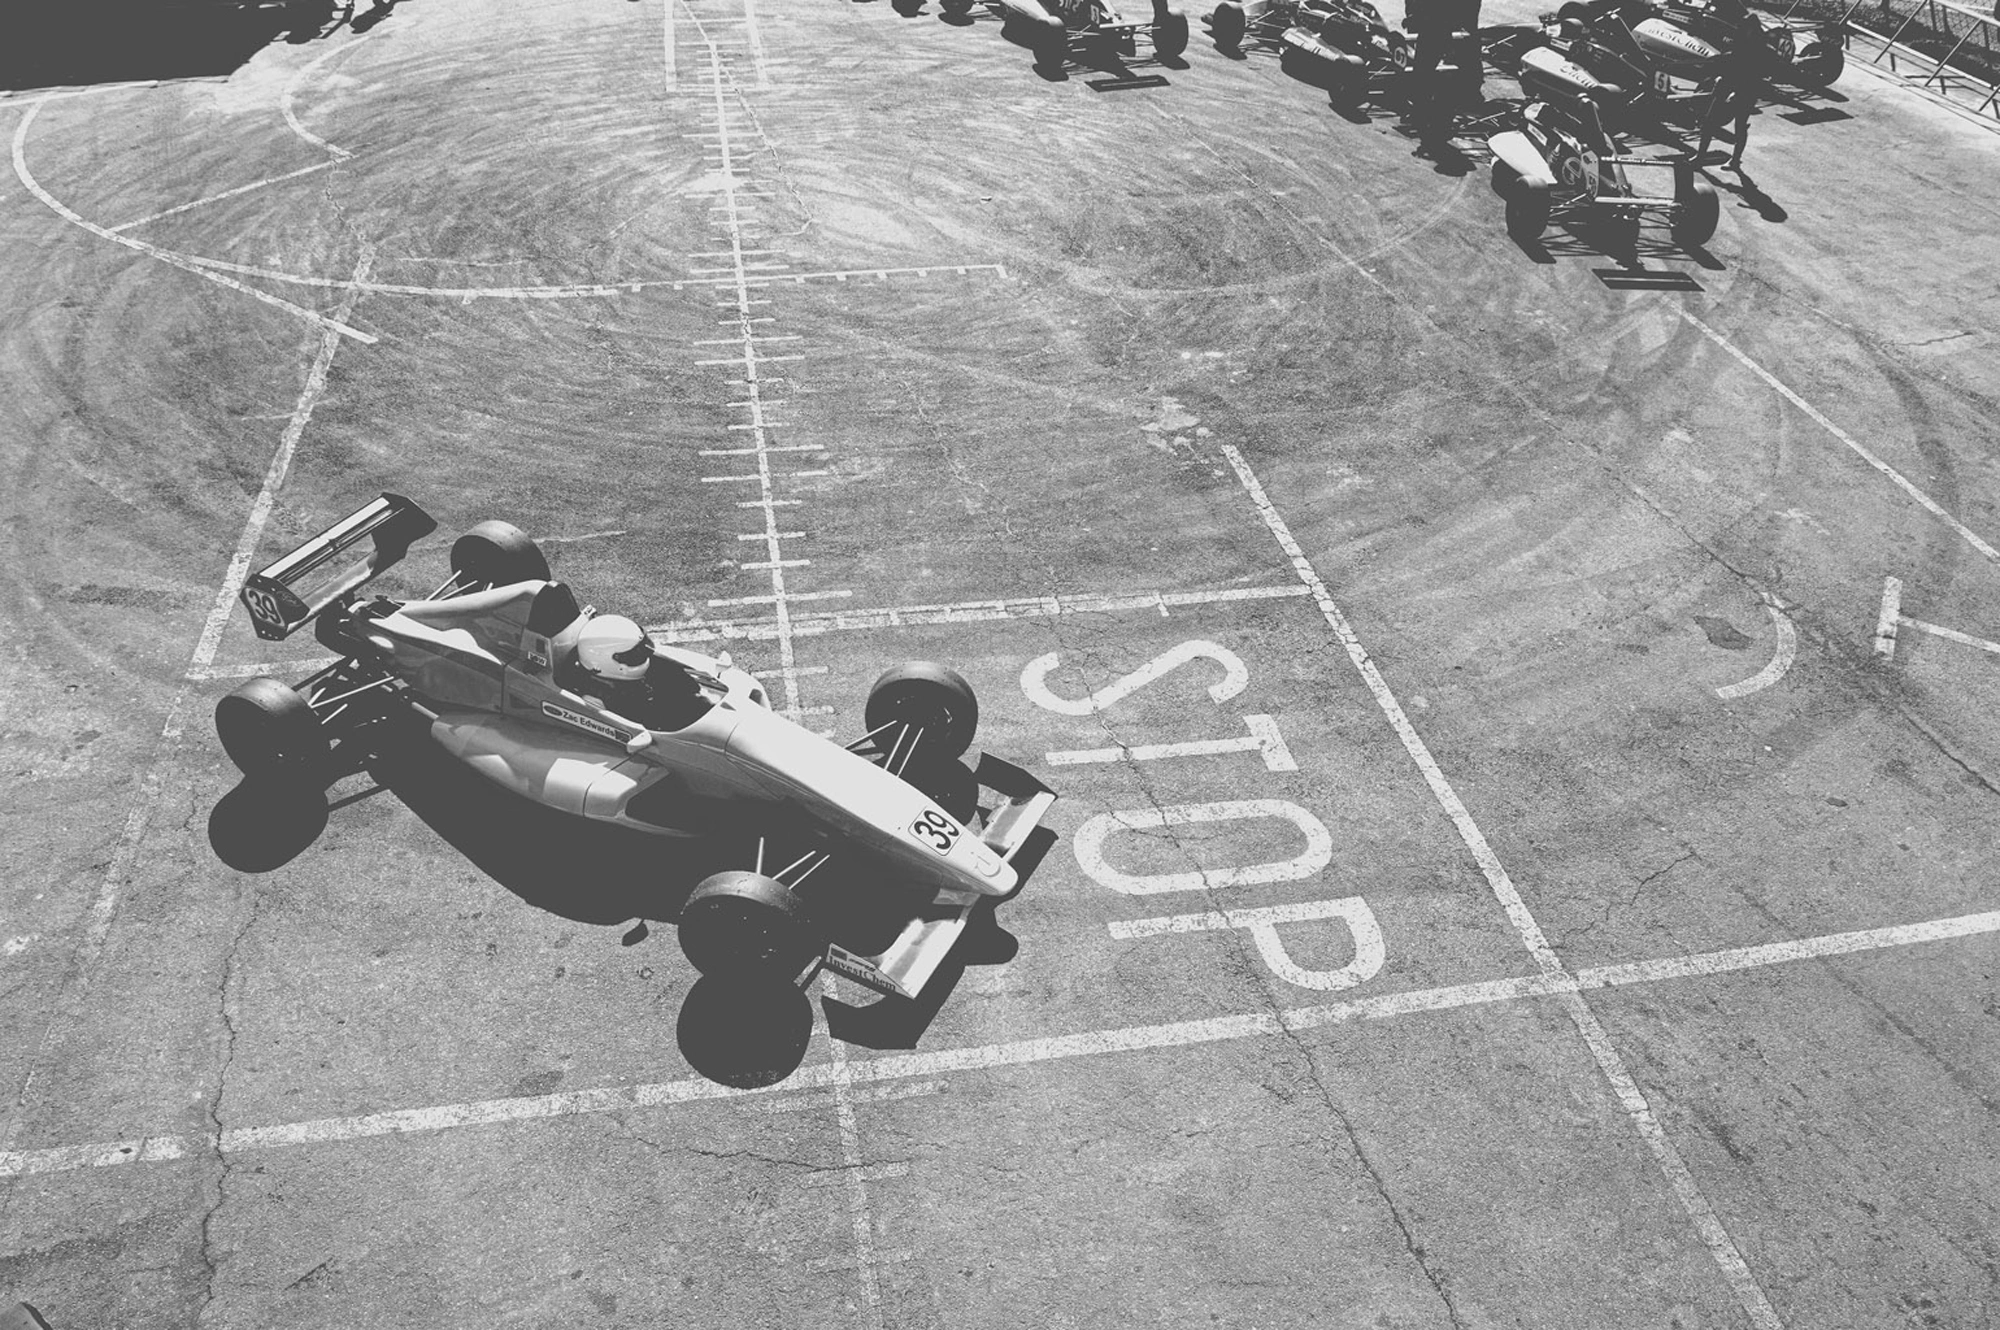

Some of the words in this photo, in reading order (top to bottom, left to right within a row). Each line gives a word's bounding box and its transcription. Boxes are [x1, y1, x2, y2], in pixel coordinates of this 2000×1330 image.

[248, 590, 282, 624] 39
[562, 710, 579, 723] Zac
[580, 716, 616, 737] Edwards
[914, 810, 960, 850] 39
[1020, 639, 1386, 991] STOP
[829, 955, 896, 992] InvestChem
